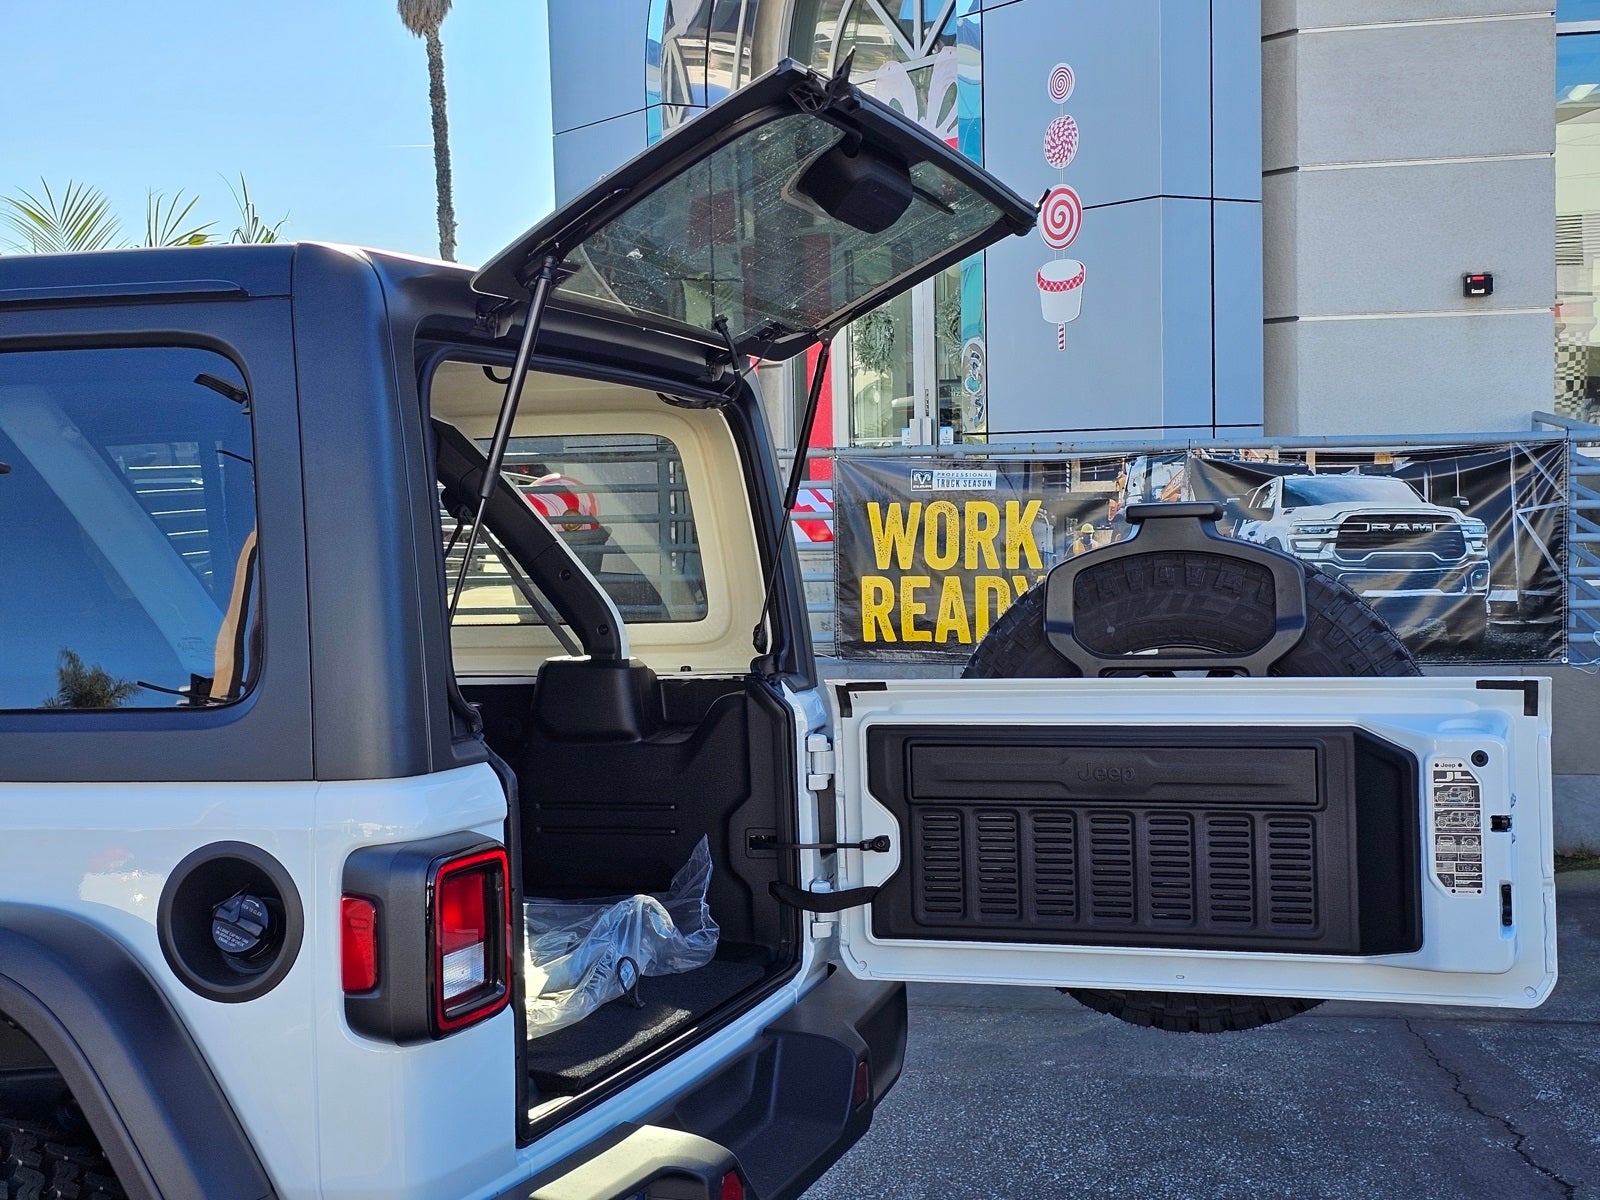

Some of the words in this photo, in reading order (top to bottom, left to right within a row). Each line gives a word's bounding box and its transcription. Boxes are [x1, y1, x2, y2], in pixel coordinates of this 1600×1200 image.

[937, 478, 960, 488] TRUCK
[962, 479, 992, 488] SEASON
[1370, 523, 1433, 532] RAM
[867, 500, 1043, 570] WORK
[1078, 761, 1136, 785] Jeep
[1434, 771, 1474, 782] JL
